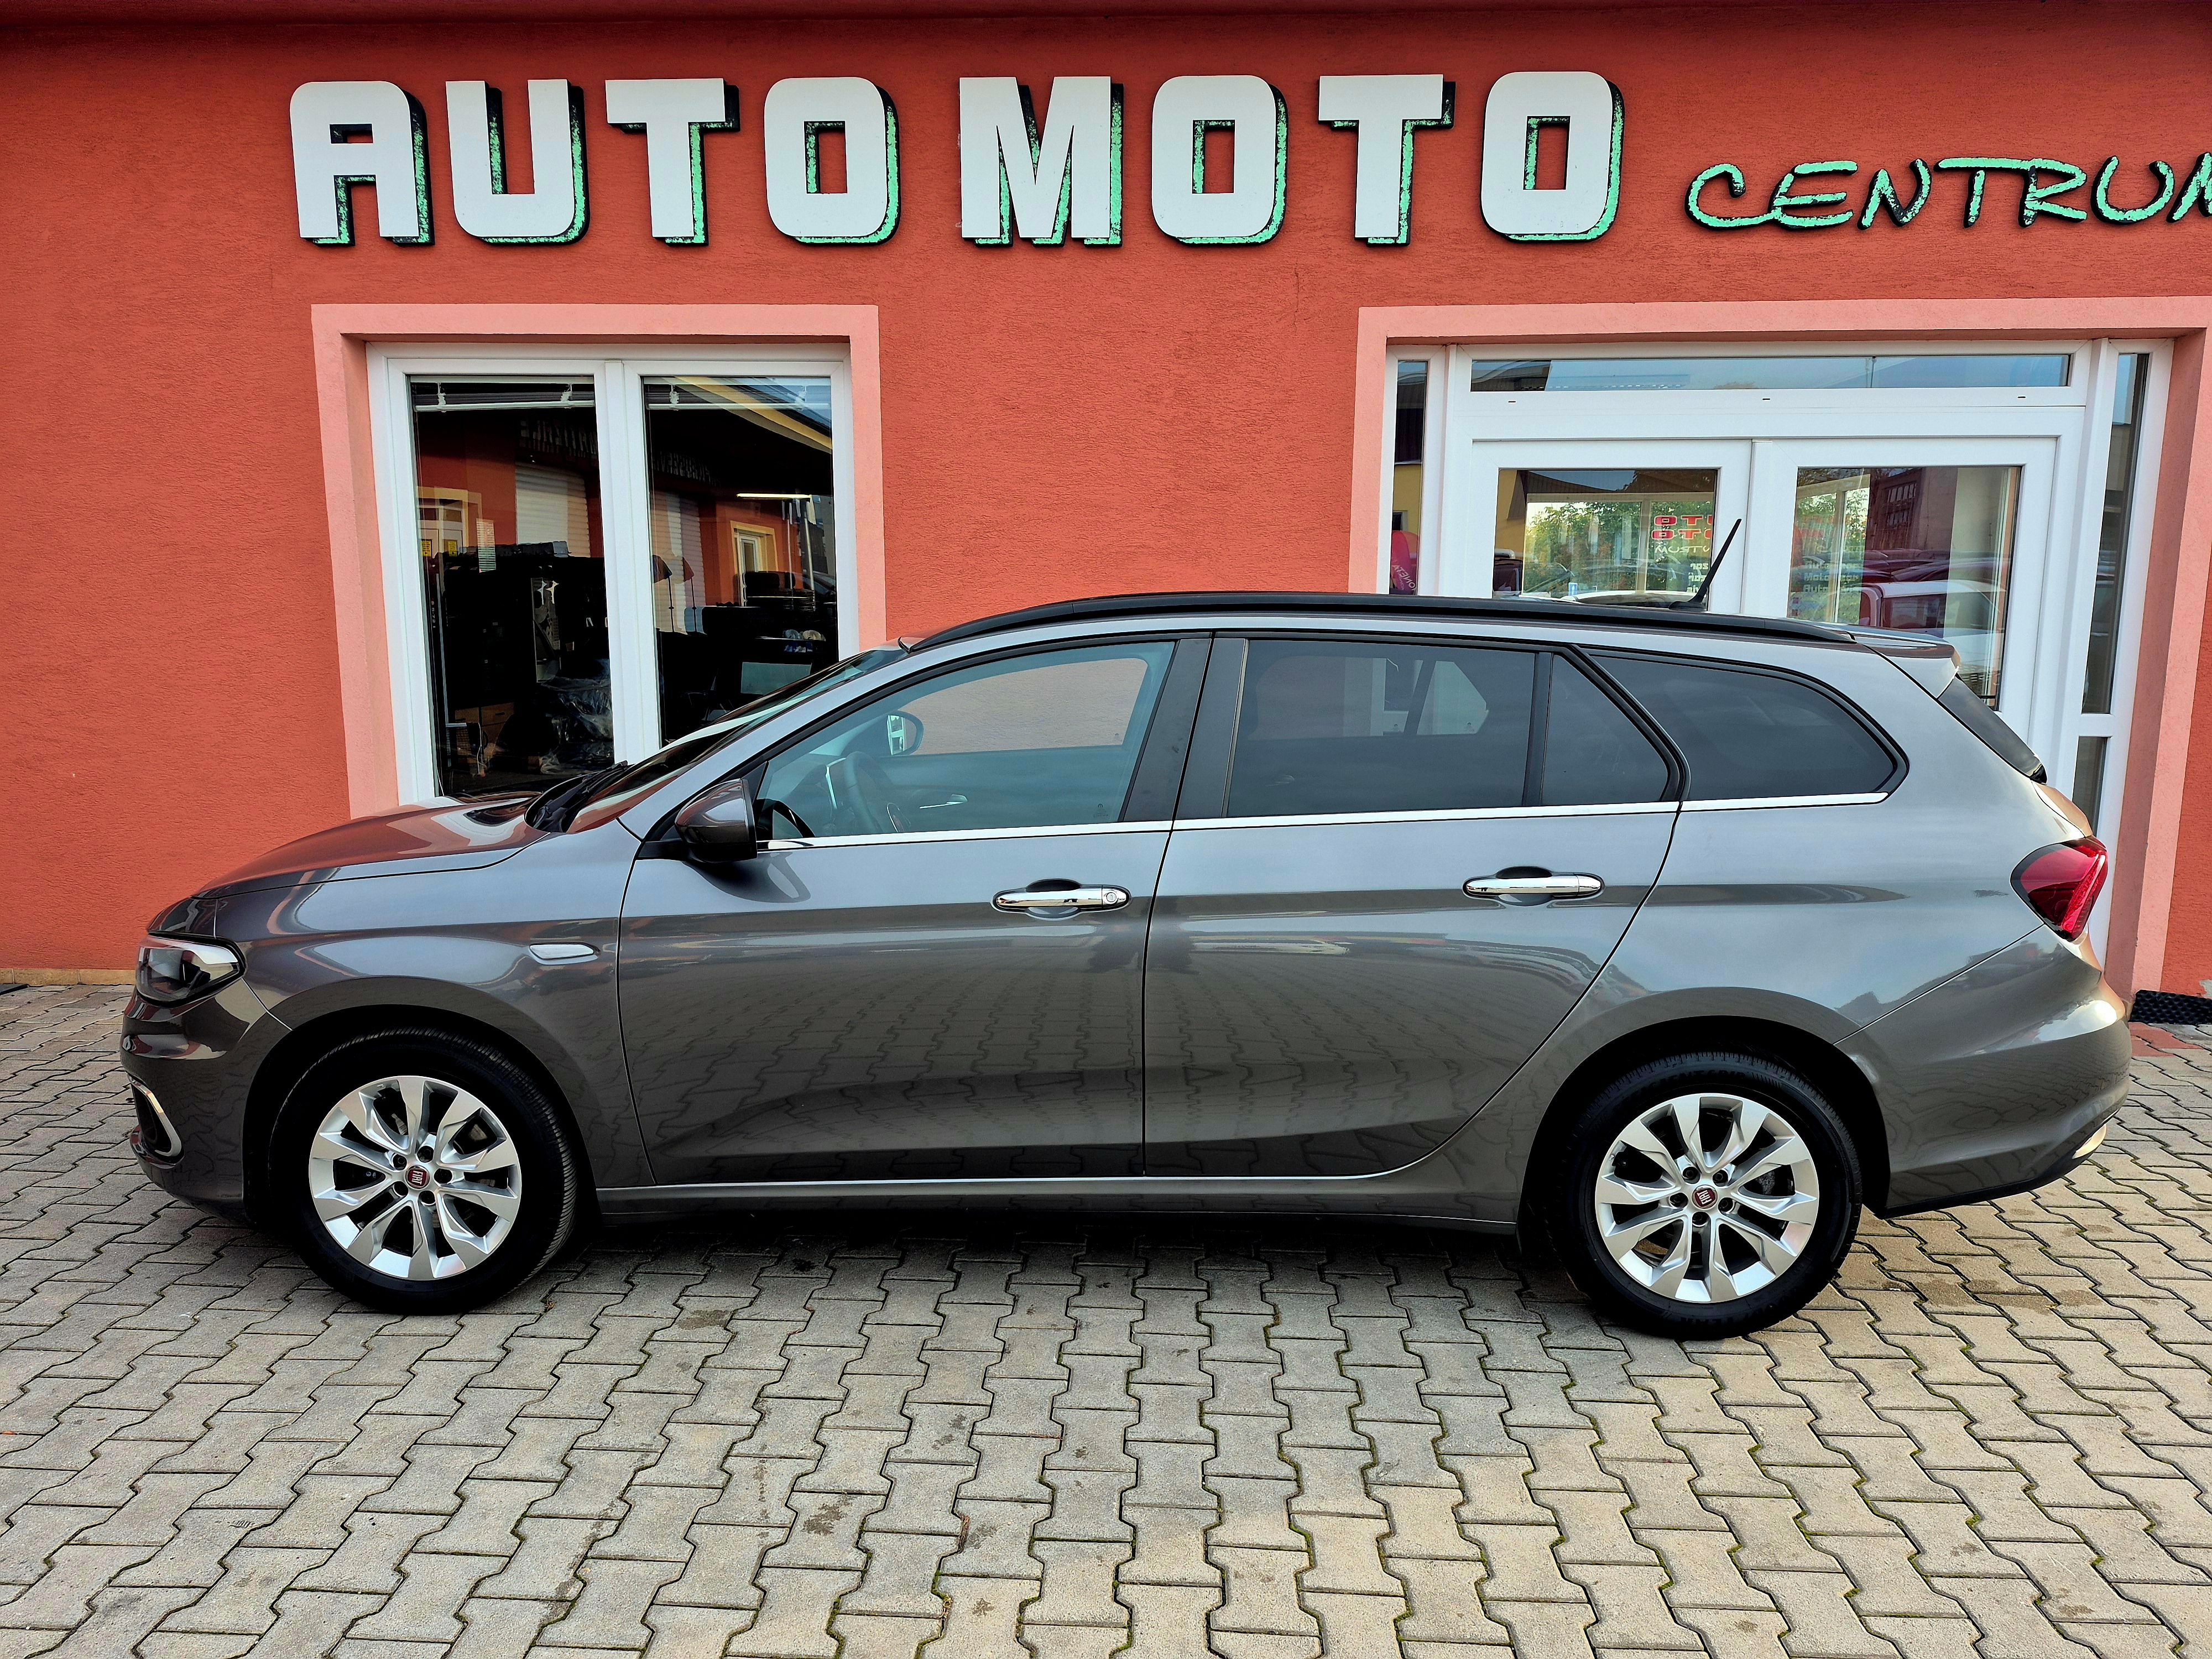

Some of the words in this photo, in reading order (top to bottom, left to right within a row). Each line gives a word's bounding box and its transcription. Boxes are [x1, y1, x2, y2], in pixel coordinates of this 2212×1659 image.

[290, 77, 901, 246] AUTO
[958, 71, 1625, 247] MOTO
[412, 1170, 424, 1185] FIAT
[1697, 1190, 1712, 1204] FIAT
